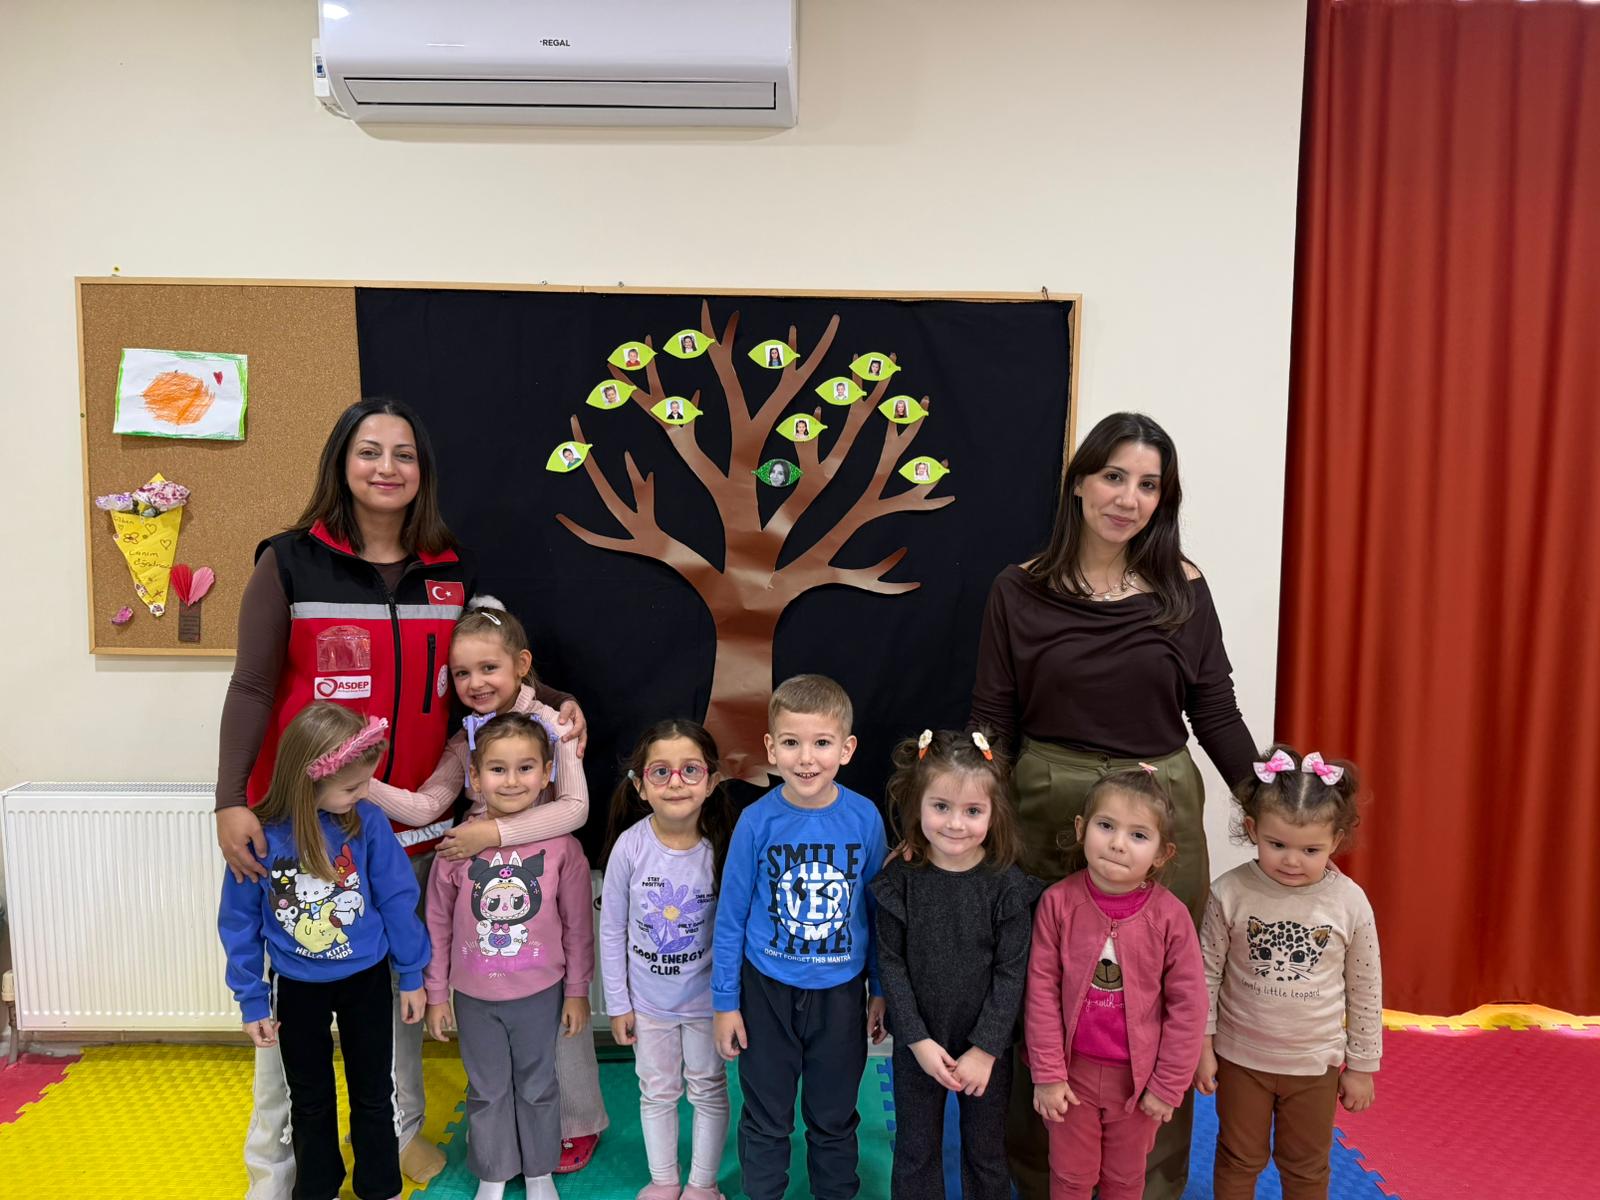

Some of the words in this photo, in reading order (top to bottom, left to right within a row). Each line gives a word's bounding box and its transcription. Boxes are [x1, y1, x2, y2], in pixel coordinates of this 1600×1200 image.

[541, 39, 571, 47] REGAL
[338, 681, 369, 690] ASDEP
[767, 843, 861, 879] SMILE
[326, 941, 350, 959] KITTY
[632, 944, 659, 963] GOOD
[661, 948, 705, 964] ENERGY
[783, 954, 810, 963] FORGET
[811, 956, 826, 964] THIS
[827, 953, 851, 963] MANTRA
[650, 964, 681, 976] CLUB
